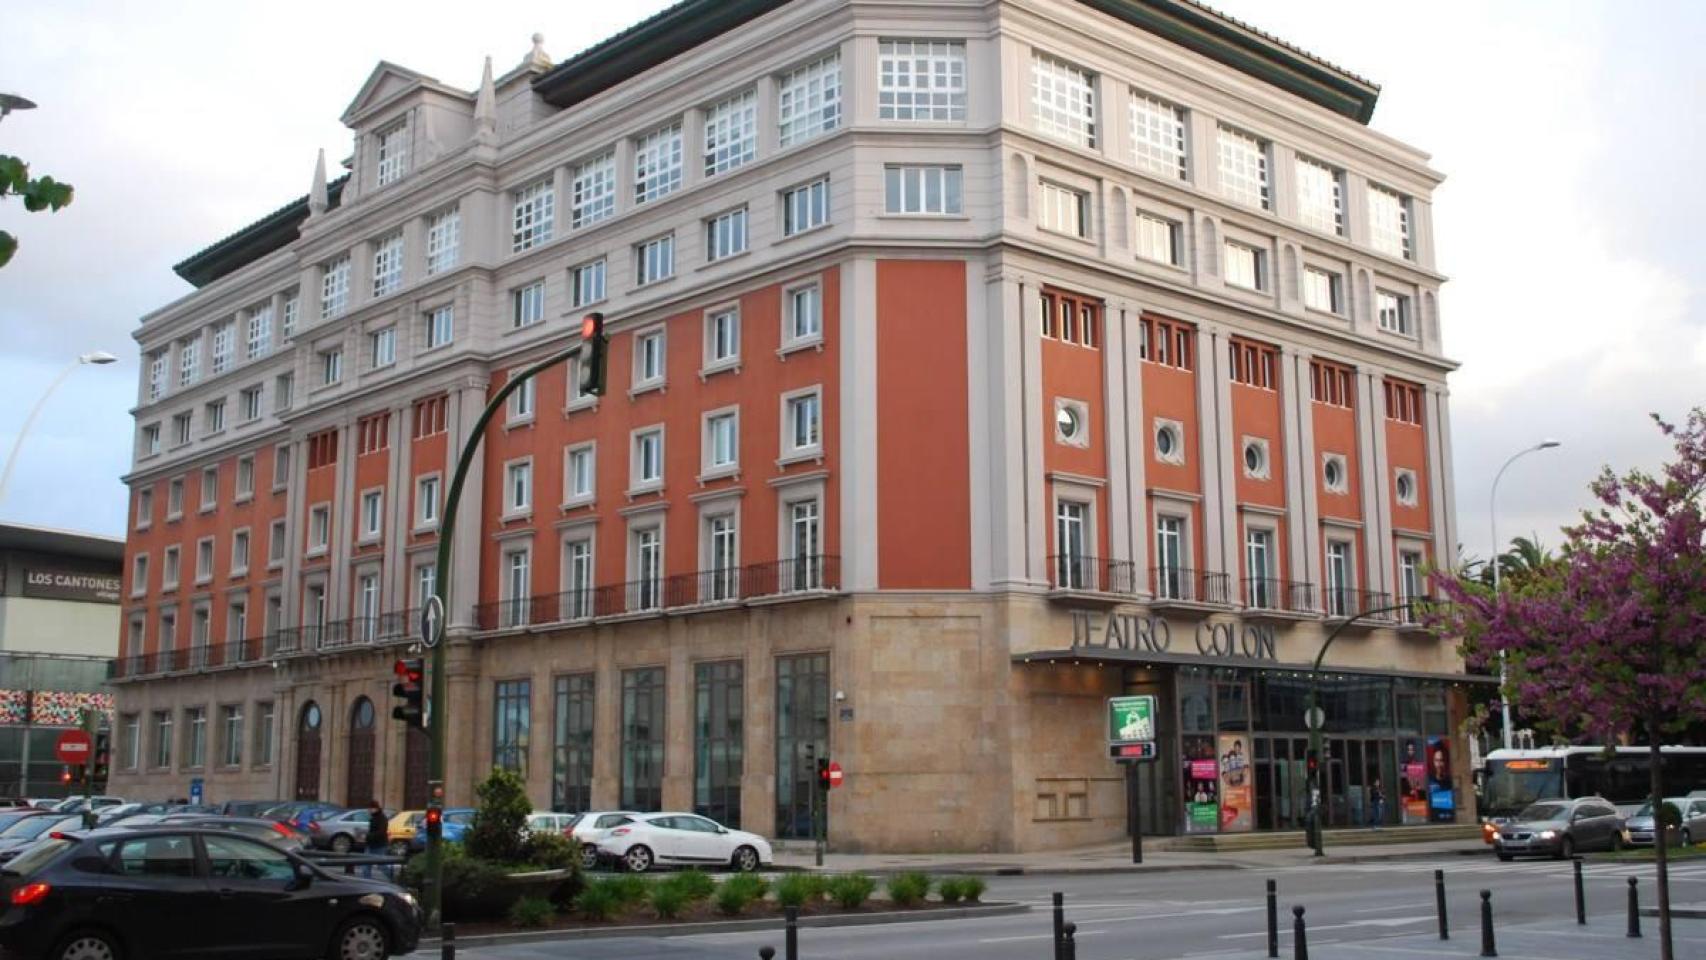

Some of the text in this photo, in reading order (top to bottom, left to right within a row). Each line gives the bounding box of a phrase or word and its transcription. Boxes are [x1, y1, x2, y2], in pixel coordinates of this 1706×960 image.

[28, 572, 120, 590] LOS CANTONES
[1071, 610, 1170, 653] TEATRO
